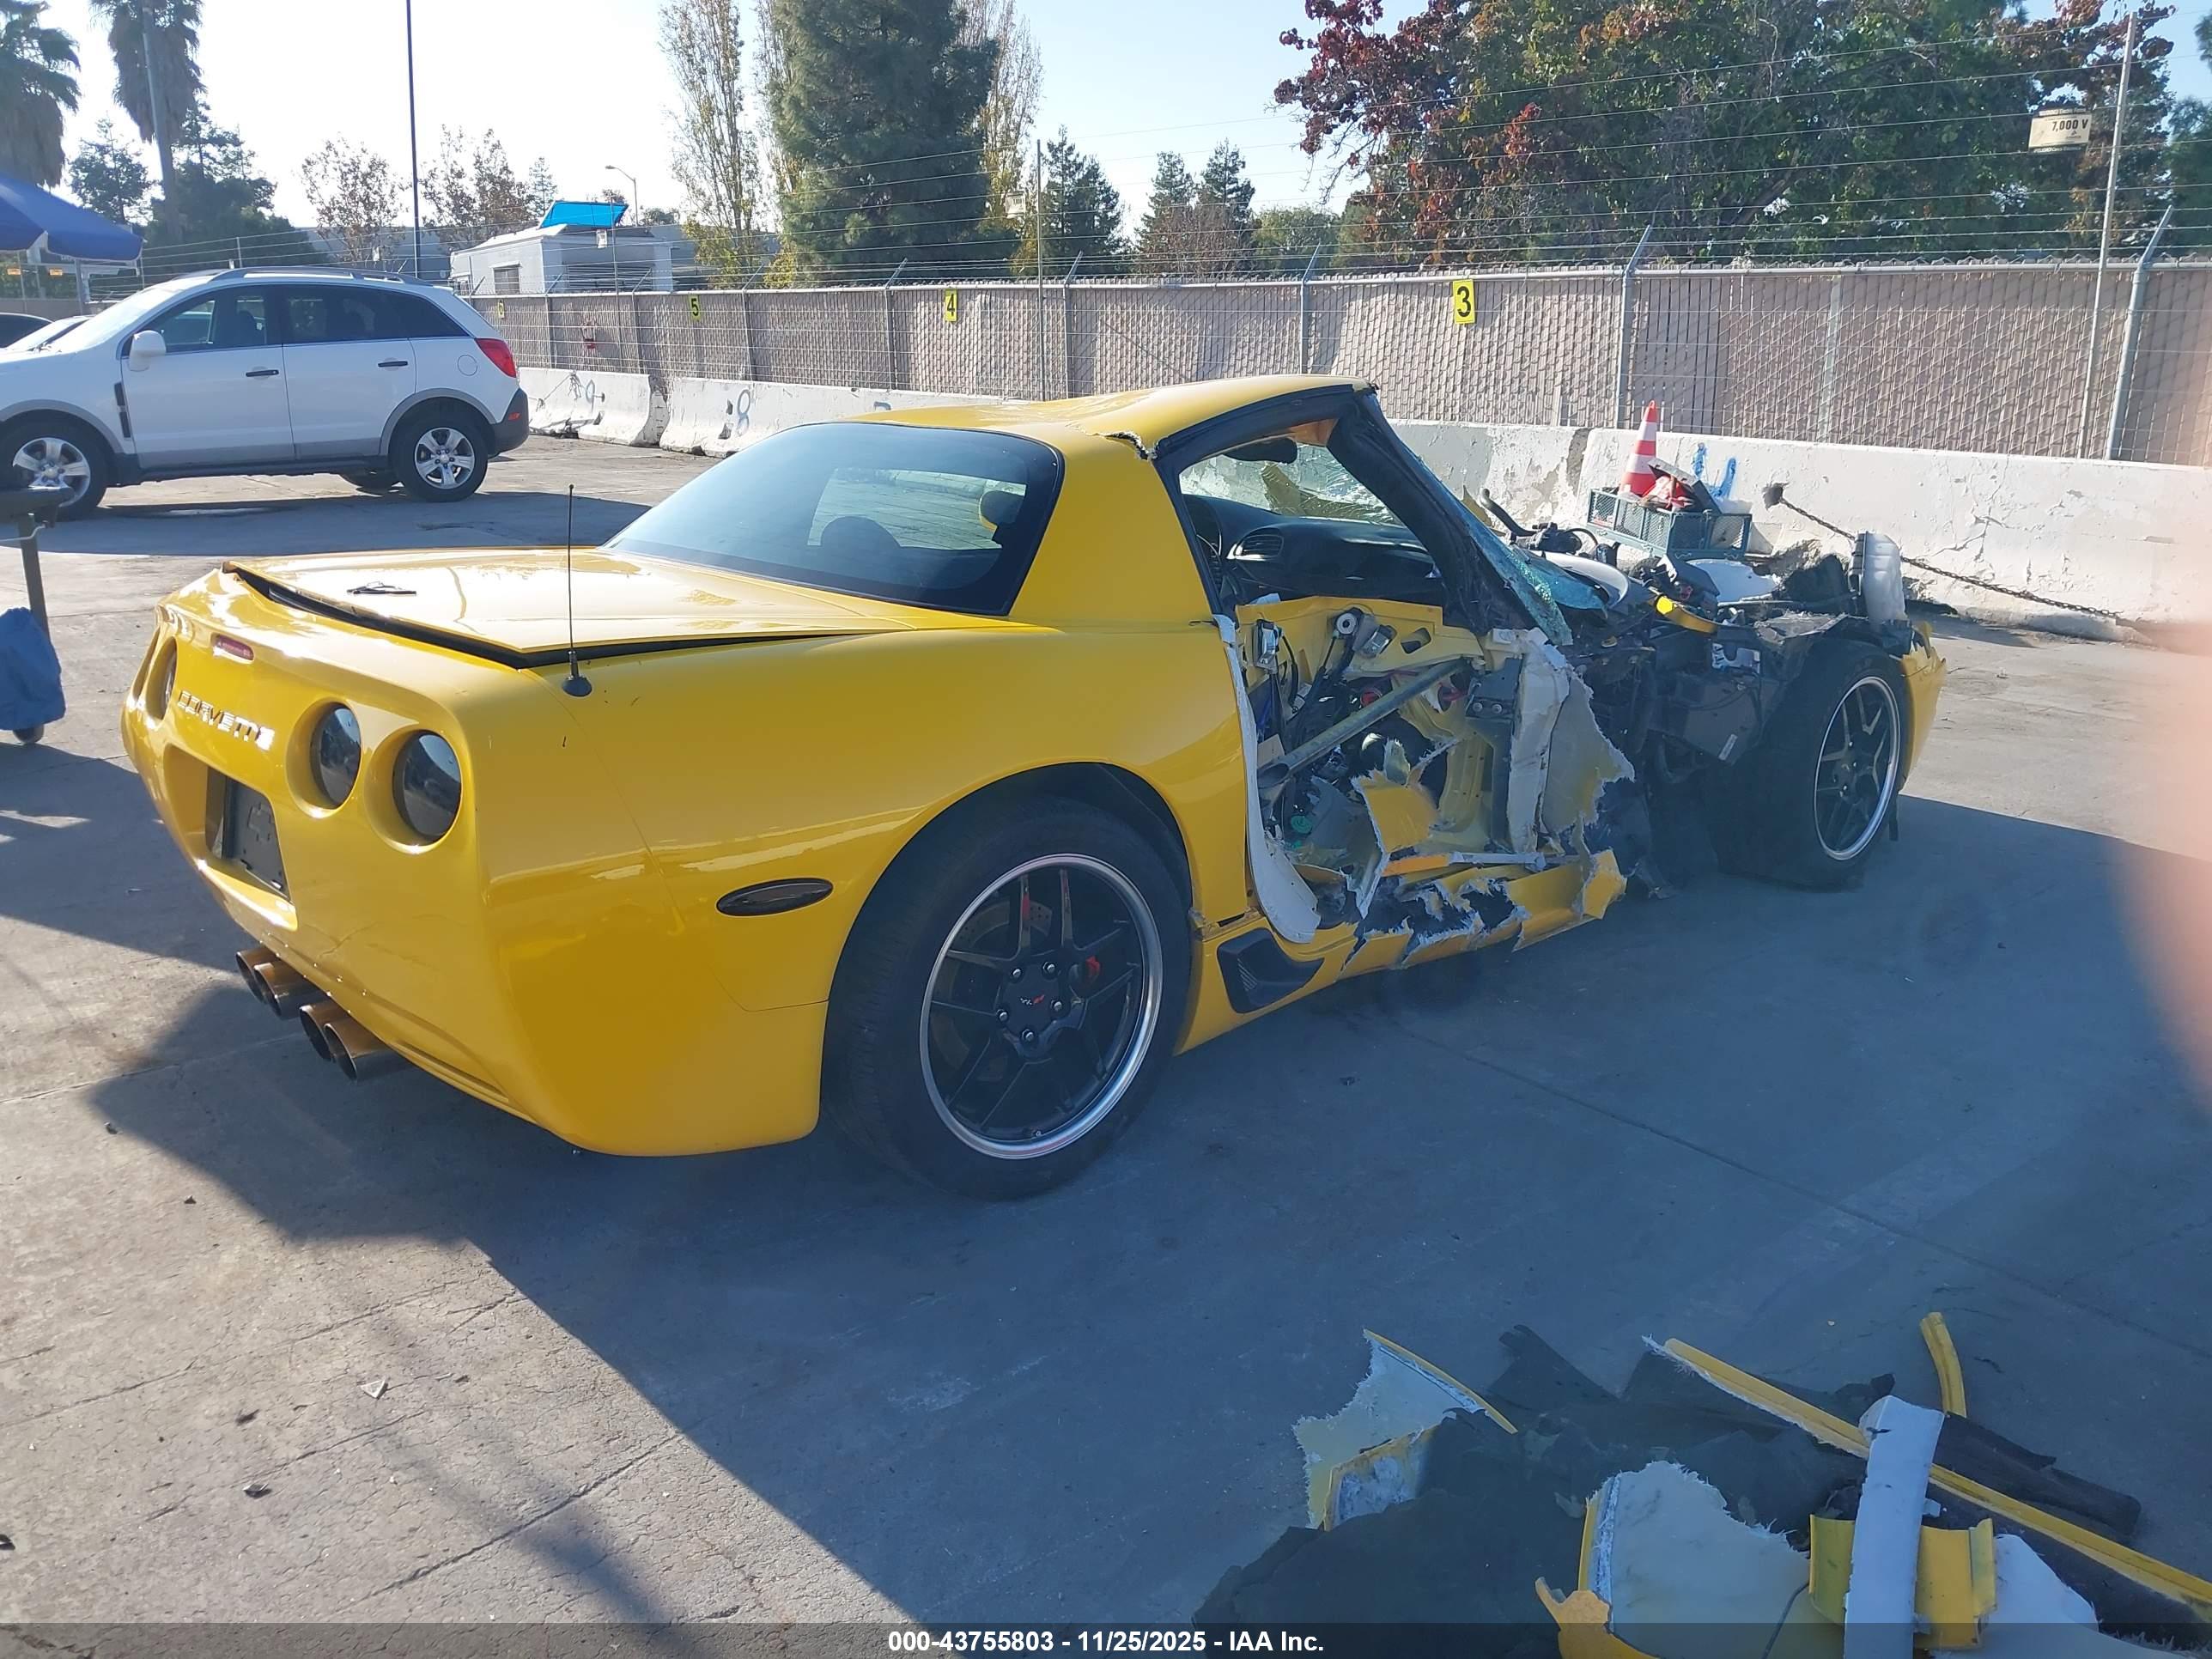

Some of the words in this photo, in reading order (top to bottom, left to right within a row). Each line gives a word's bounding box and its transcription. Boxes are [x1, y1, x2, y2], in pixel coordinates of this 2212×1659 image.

[2052, 119, 2079, 132] 7,000
[2081, 118, 2089, 130] V
[690, 298, 699, 317] 5
[947, 293, 956, 317] 4
[1456, 286, 1472, 318] 3
